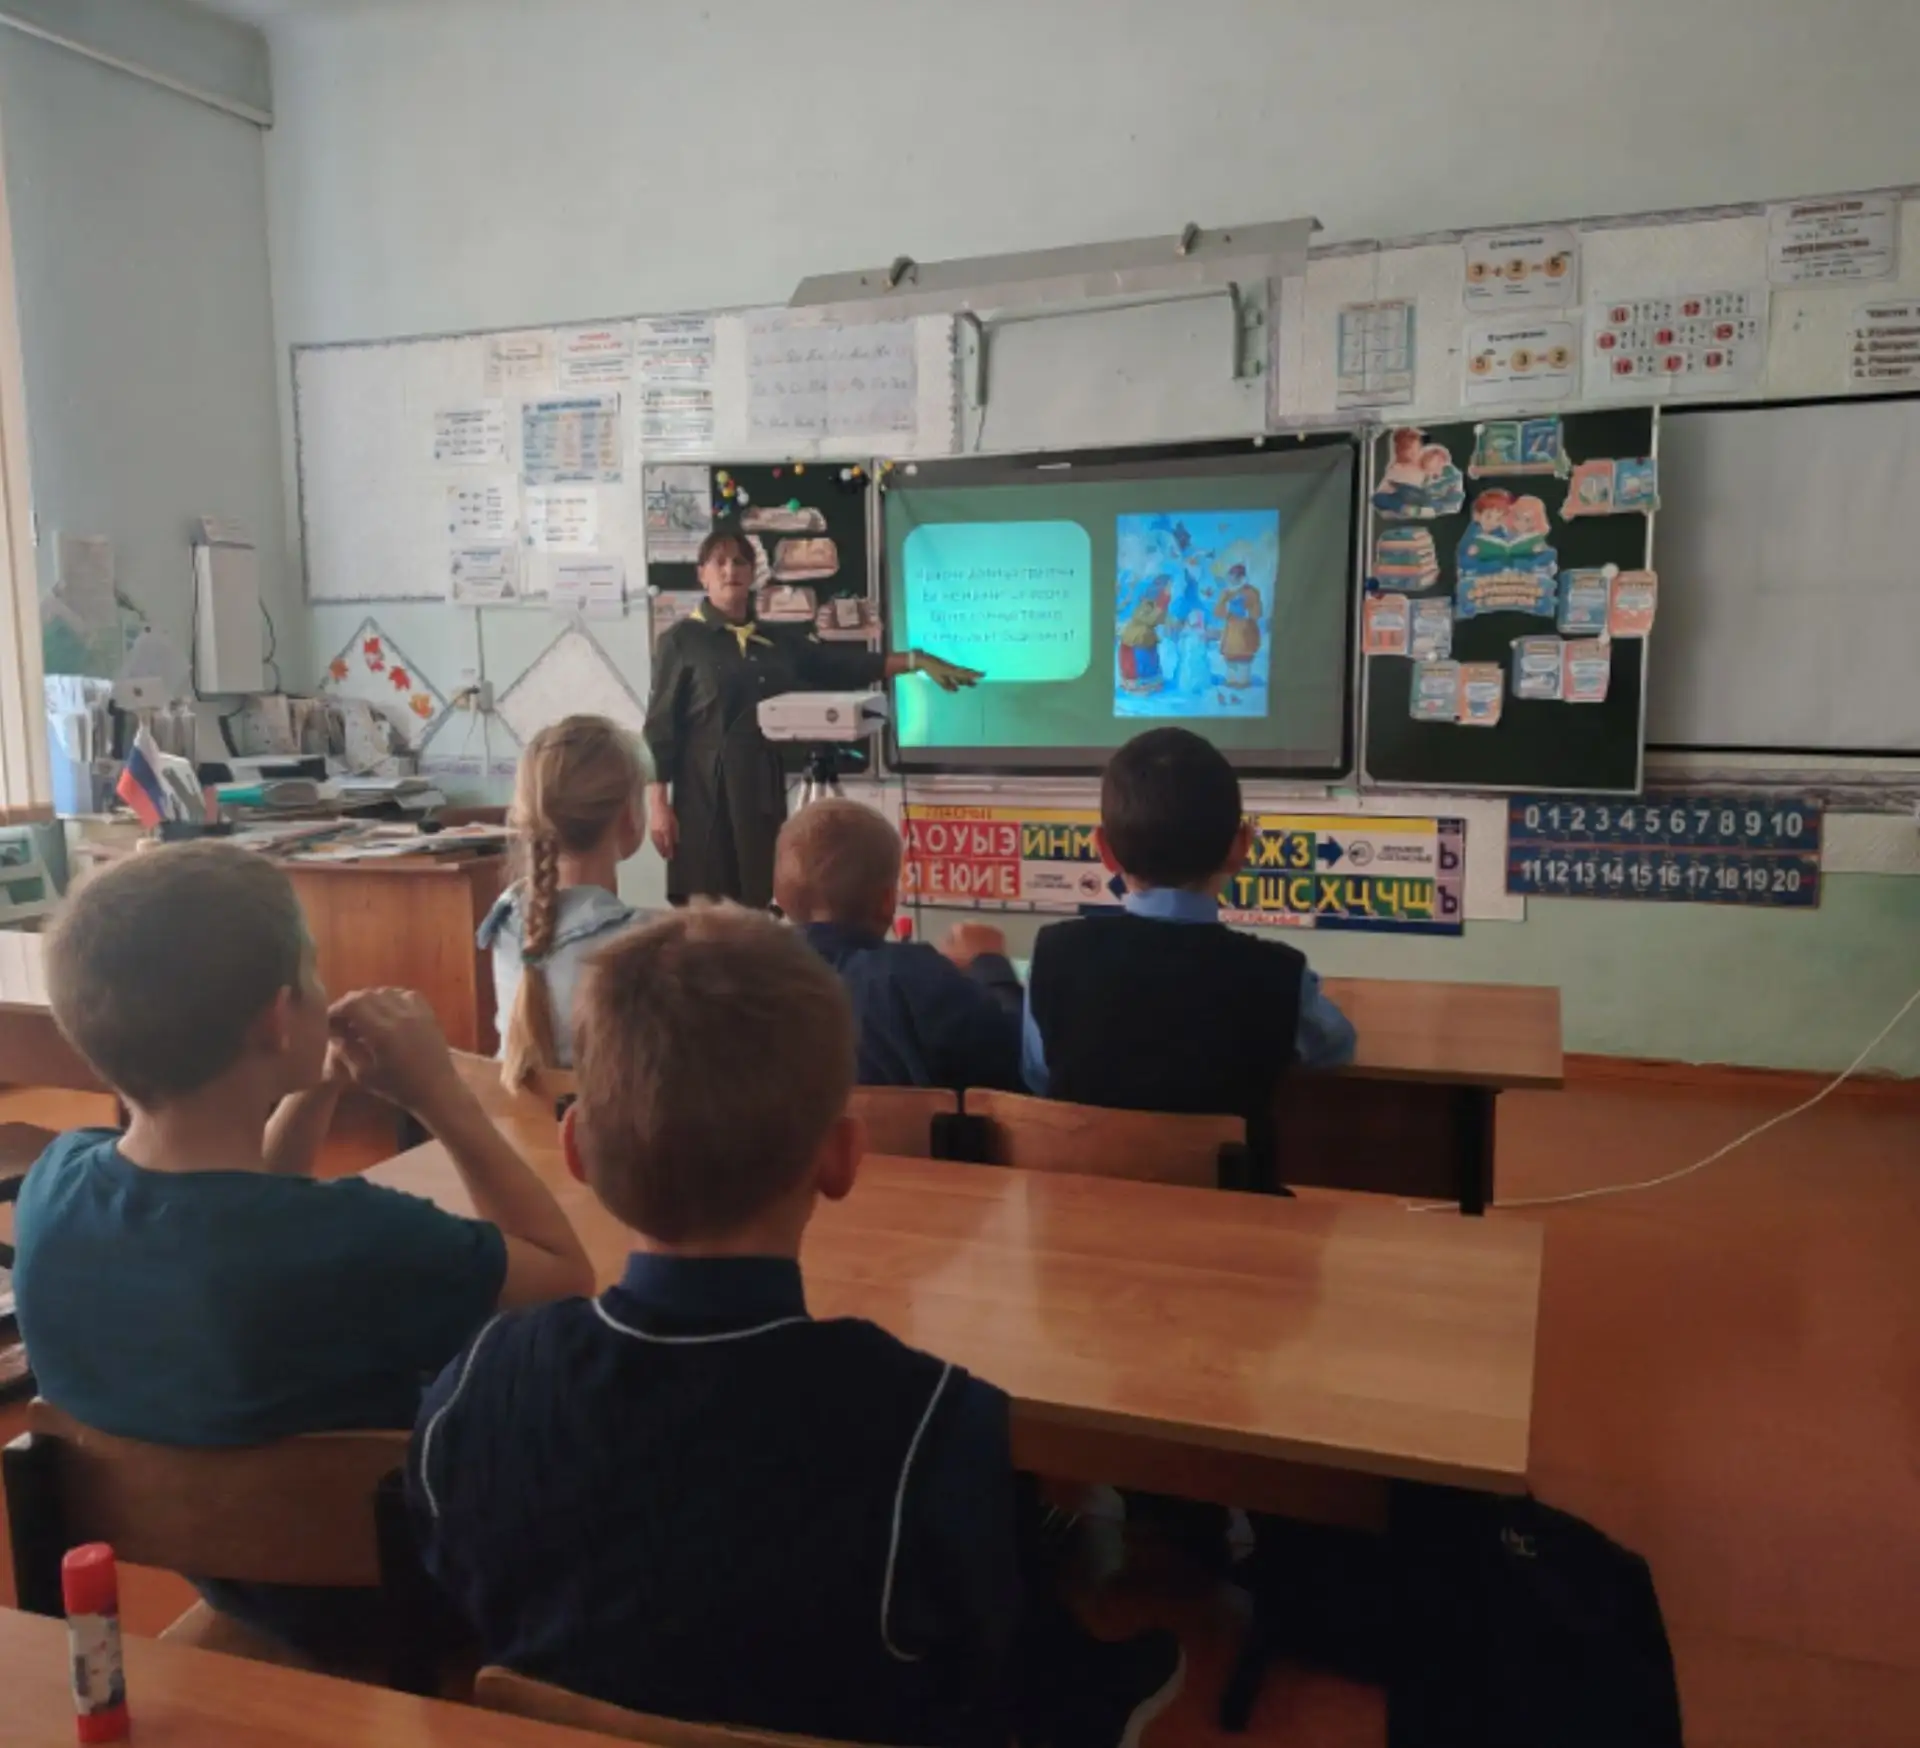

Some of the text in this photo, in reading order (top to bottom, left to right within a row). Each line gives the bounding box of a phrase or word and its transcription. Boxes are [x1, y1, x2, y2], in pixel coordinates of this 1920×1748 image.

[1525, 807, 1803, 836] 0 1 2 3 4 5 6 7 8 9 10
[1521, 860, 1801, 892] 11 12 13 14 15 16 17 18 19 20
